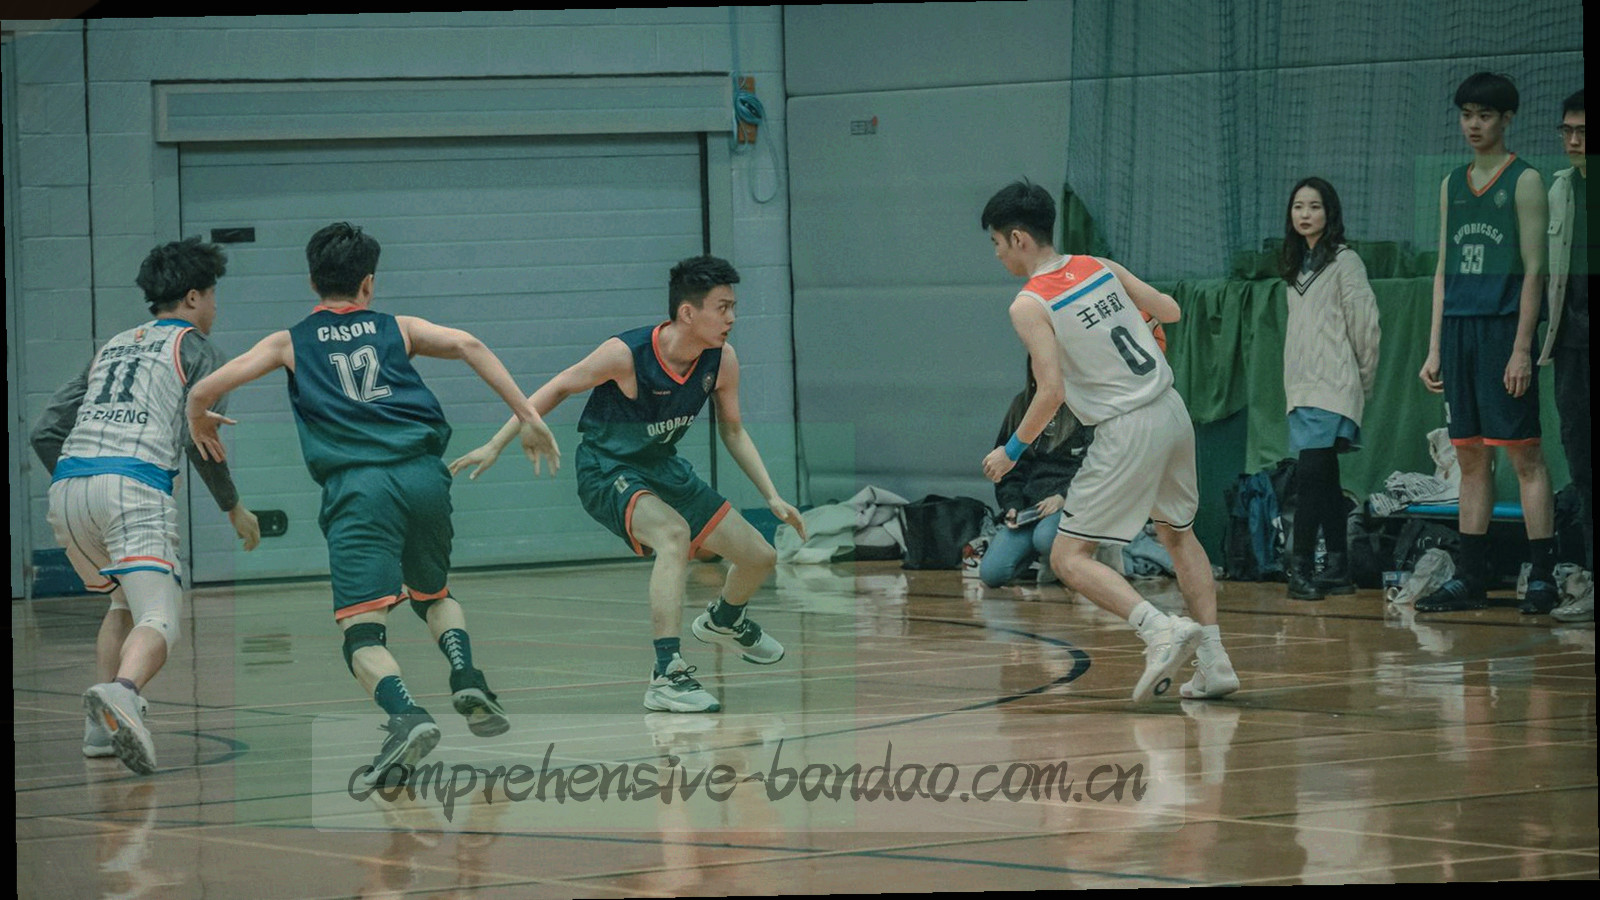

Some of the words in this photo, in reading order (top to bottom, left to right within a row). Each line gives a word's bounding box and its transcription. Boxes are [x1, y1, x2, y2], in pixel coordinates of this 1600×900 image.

[1460, 243, 1485, 275] 33
[317, 320, 377, 342] CASON
[1110, 325, 1156, 376] 0
[94, 357, 141, 404] 11
[328, 345, 393, 402] 12
